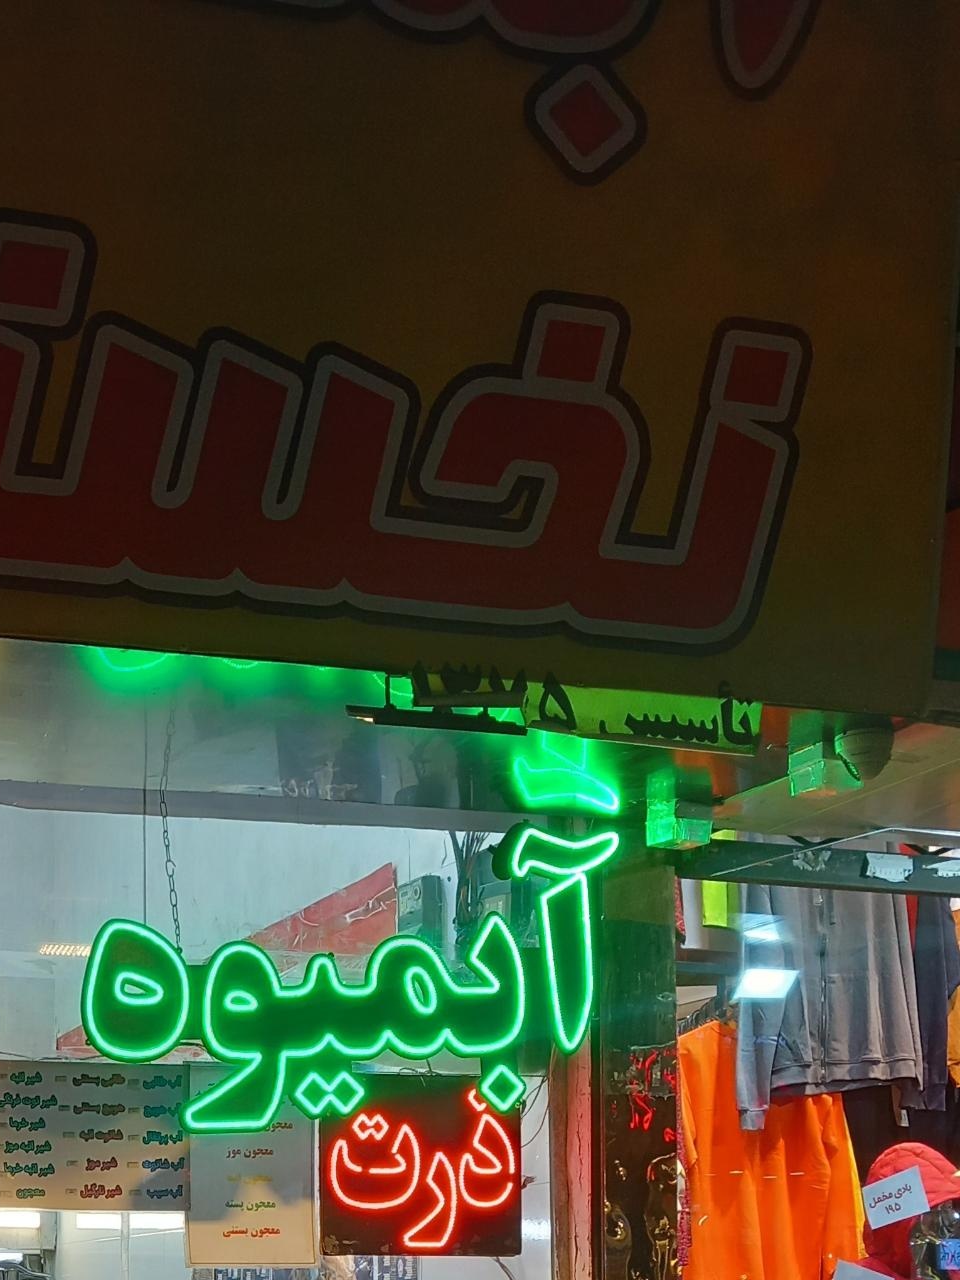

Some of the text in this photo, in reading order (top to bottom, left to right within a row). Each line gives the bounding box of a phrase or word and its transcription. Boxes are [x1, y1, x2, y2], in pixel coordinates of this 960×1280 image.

[85, 828, 620, 1131] آبمیوه
[105, 1184, 123, 1199] شیر
[329, 1089, 516, 1248] ذرت
